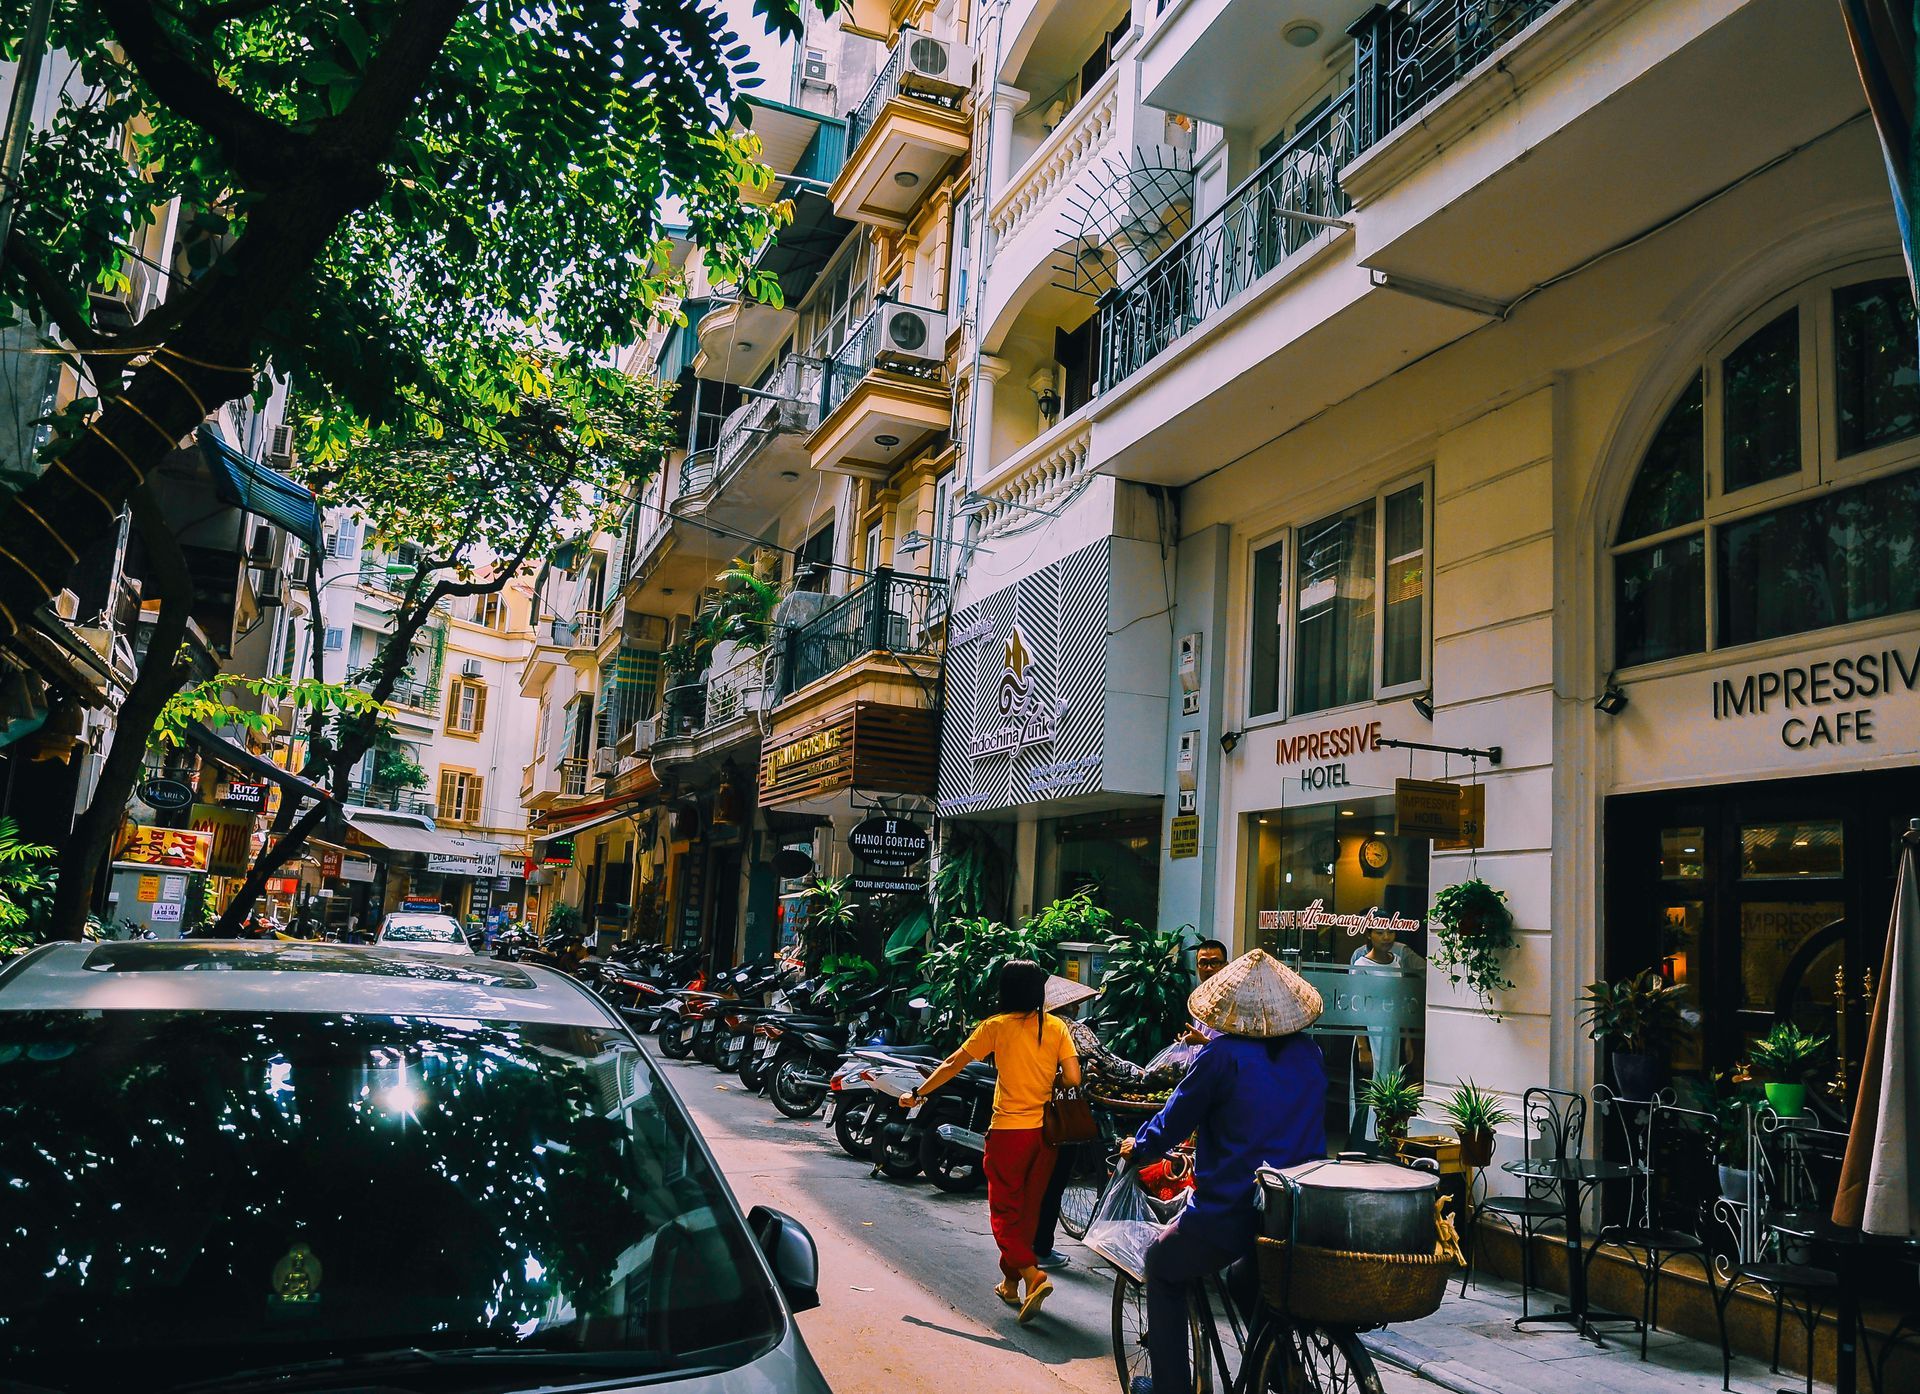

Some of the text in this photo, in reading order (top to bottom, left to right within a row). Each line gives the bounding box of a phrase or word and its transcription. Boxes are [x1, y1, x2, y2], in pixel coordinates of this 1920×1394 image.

[1782, 709, 1873, 750] CAFE
[1276, 721, 1382, 765] IMPRESSIVE
[1301, 763, 1350, 792] HOTEL
[233, 783, 259, 795] RITZ
[855, 834, 926, 849] HANOI GORTAGE
[477, 866, 493, 875] 24h
[855, 880, 920, 891] TOUR INFORMATION
[1304, 899, 1420, 936] Home away from home
